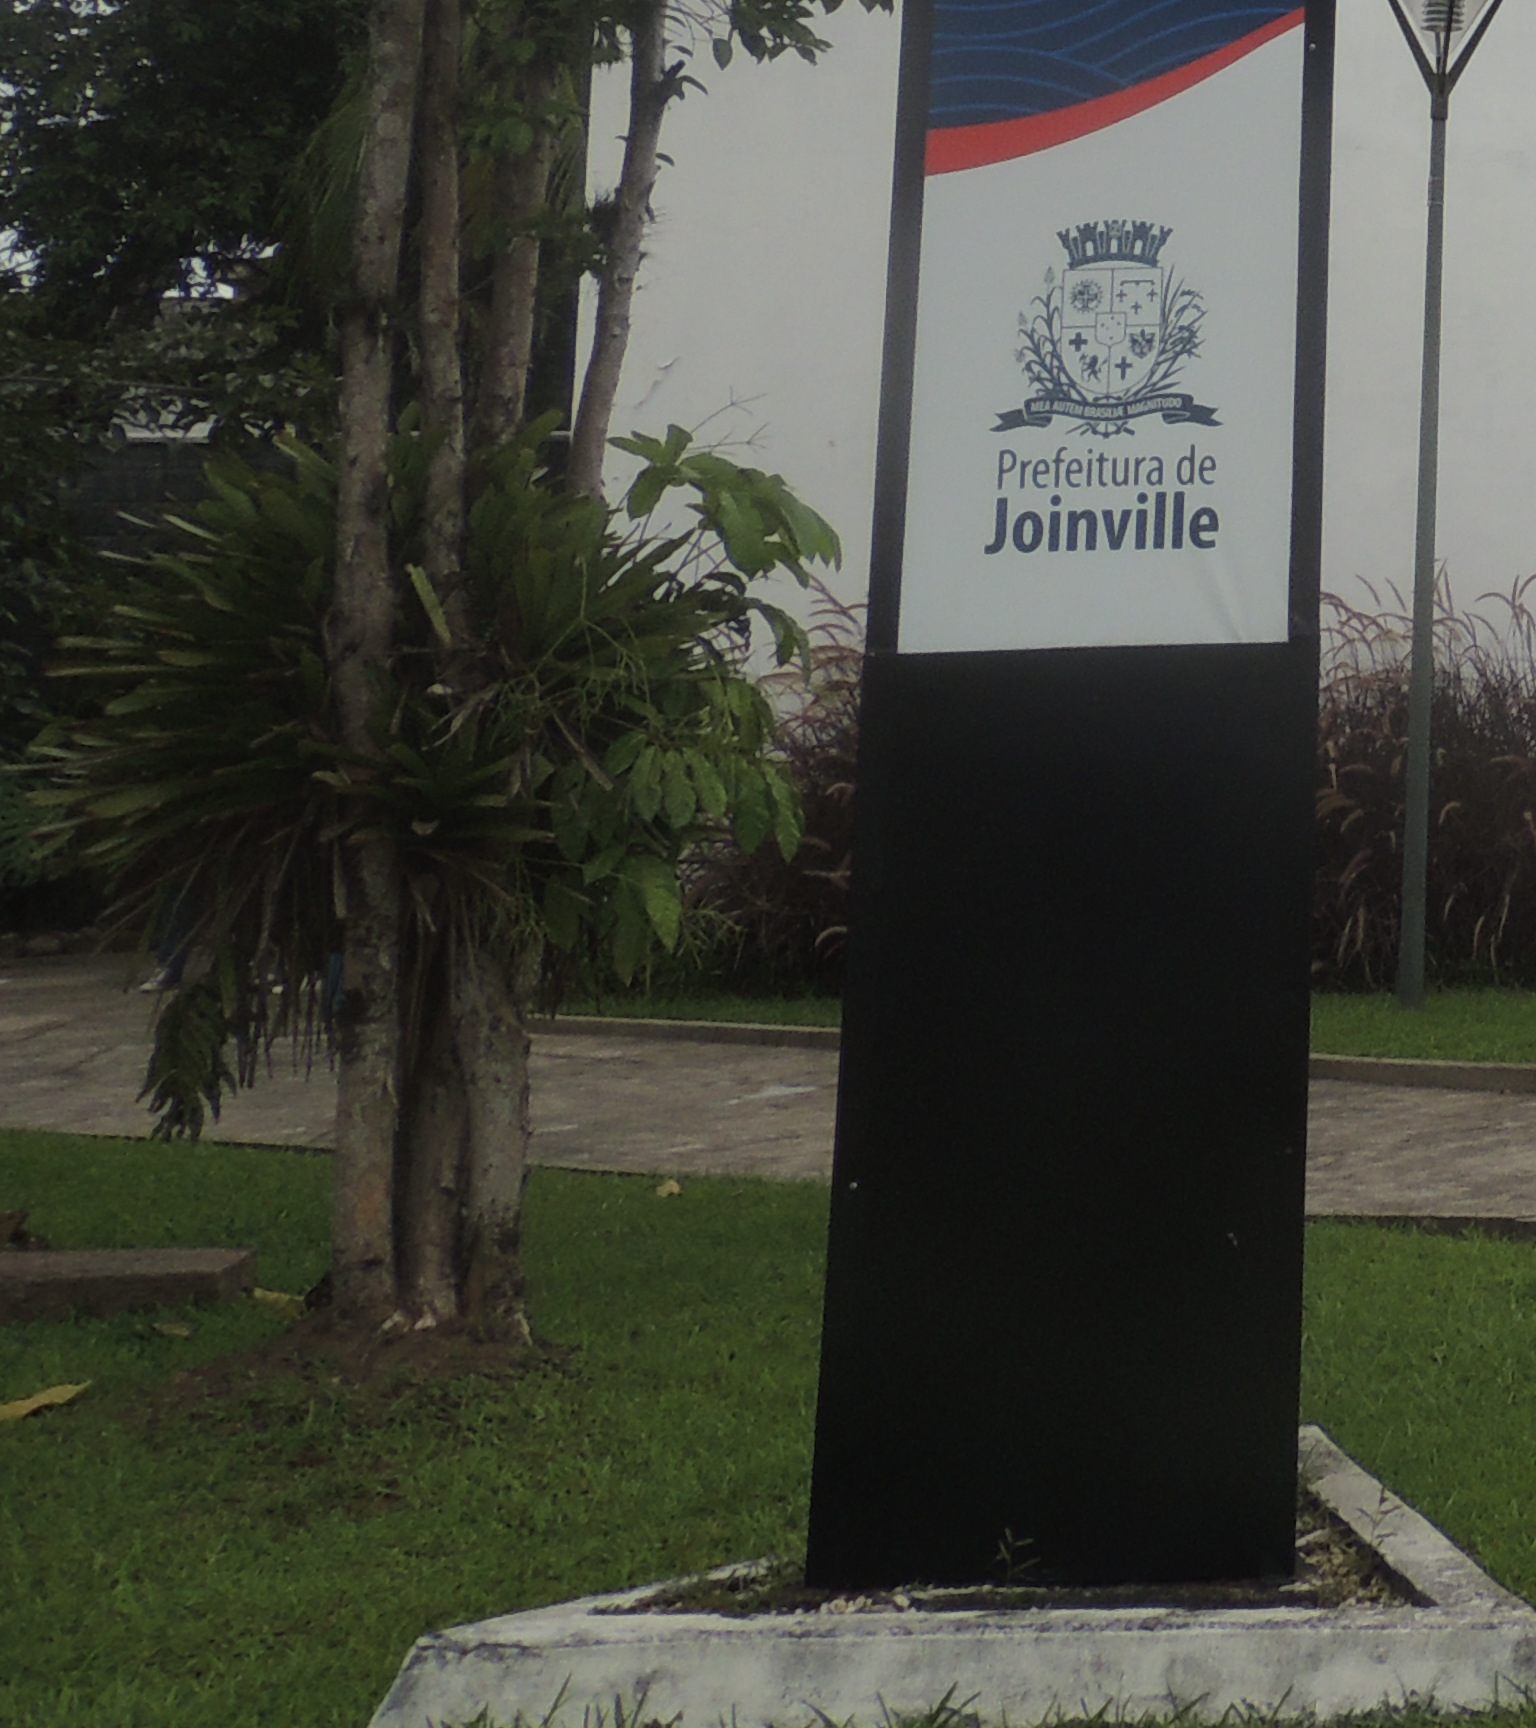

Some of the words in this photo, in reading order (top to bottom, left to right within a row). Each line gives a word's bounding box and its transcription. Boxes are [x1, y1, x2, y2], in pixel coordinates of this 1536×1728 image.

[997, 446, 1164, 490] Prefeitura
[1176, 443, 1217, 486] de
[983, 490, 1220, 555] Joinville
